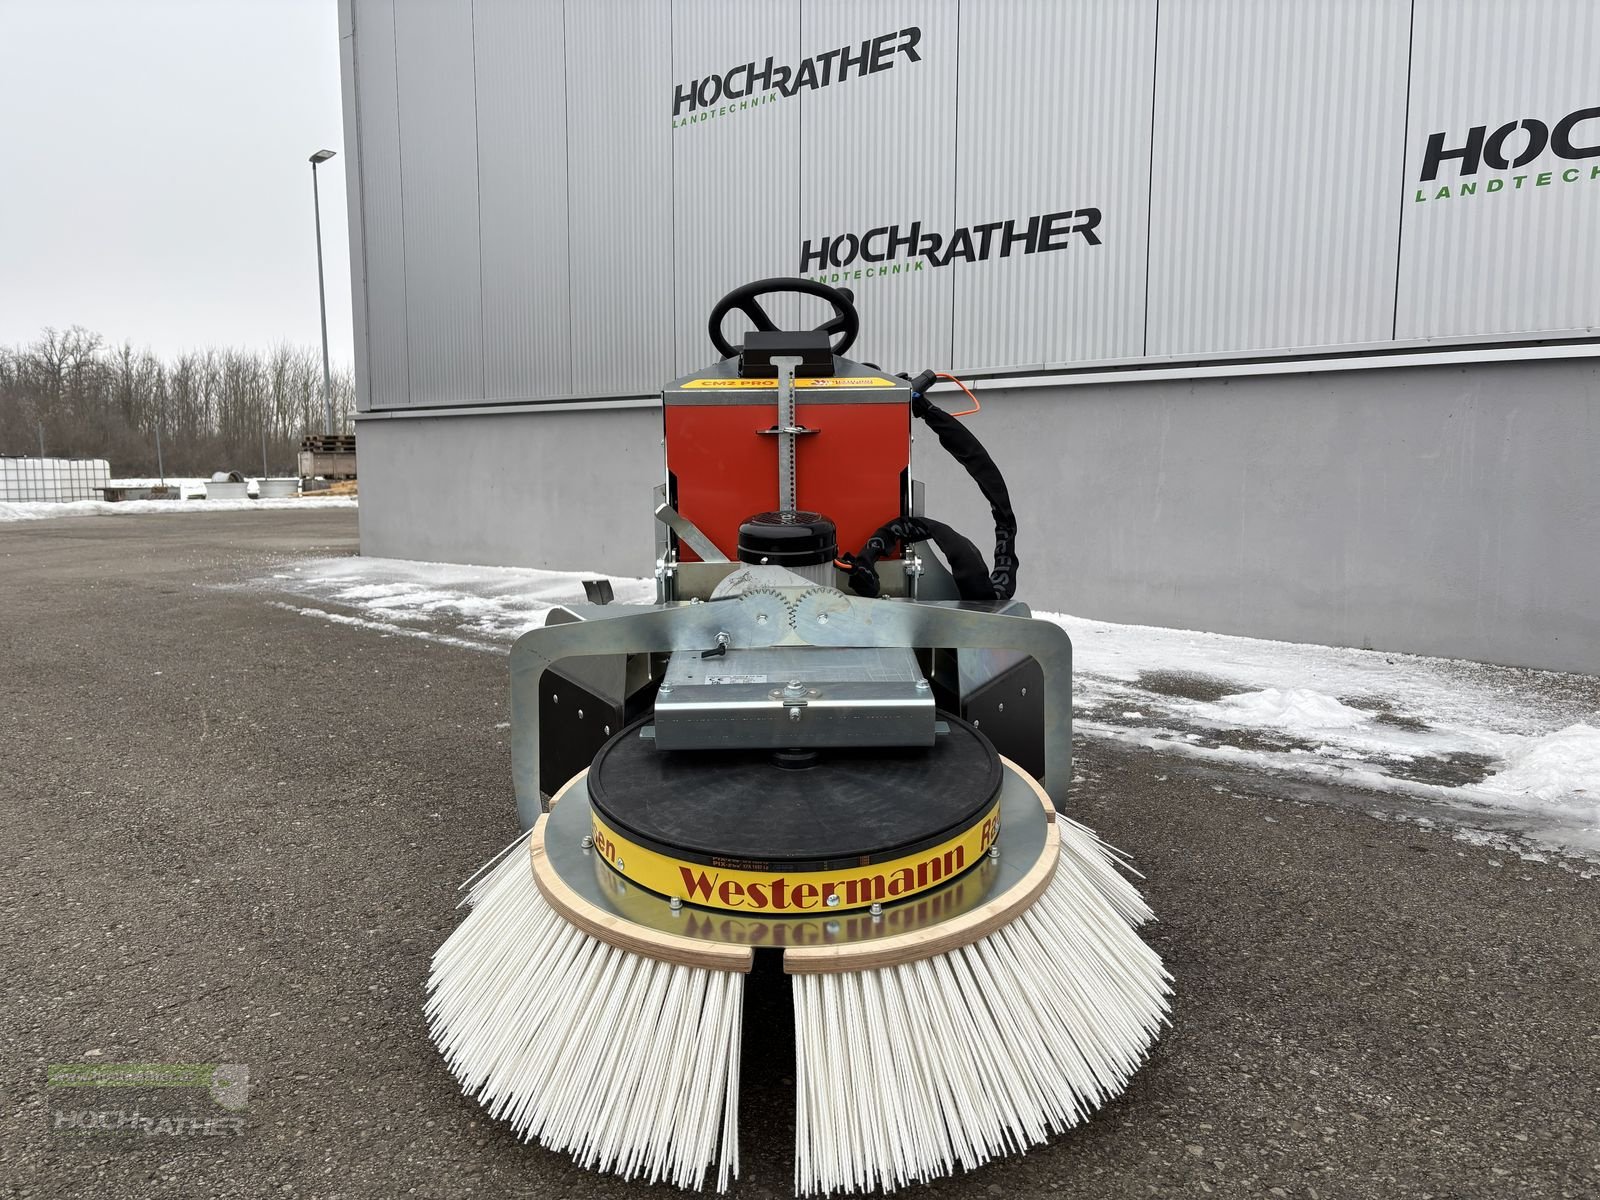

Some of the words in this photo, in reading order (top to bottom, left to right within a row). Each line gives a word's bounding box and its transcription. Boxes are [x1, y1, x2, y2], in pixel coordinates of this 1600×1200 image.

[672, 26, 922, 117] HOCHRATHER
[672, 92, 778, 128] LANDTECHNIK
[800, 207, 1102, 274] HOCHRATHER
[679, 843, 966, 911] Westermann
